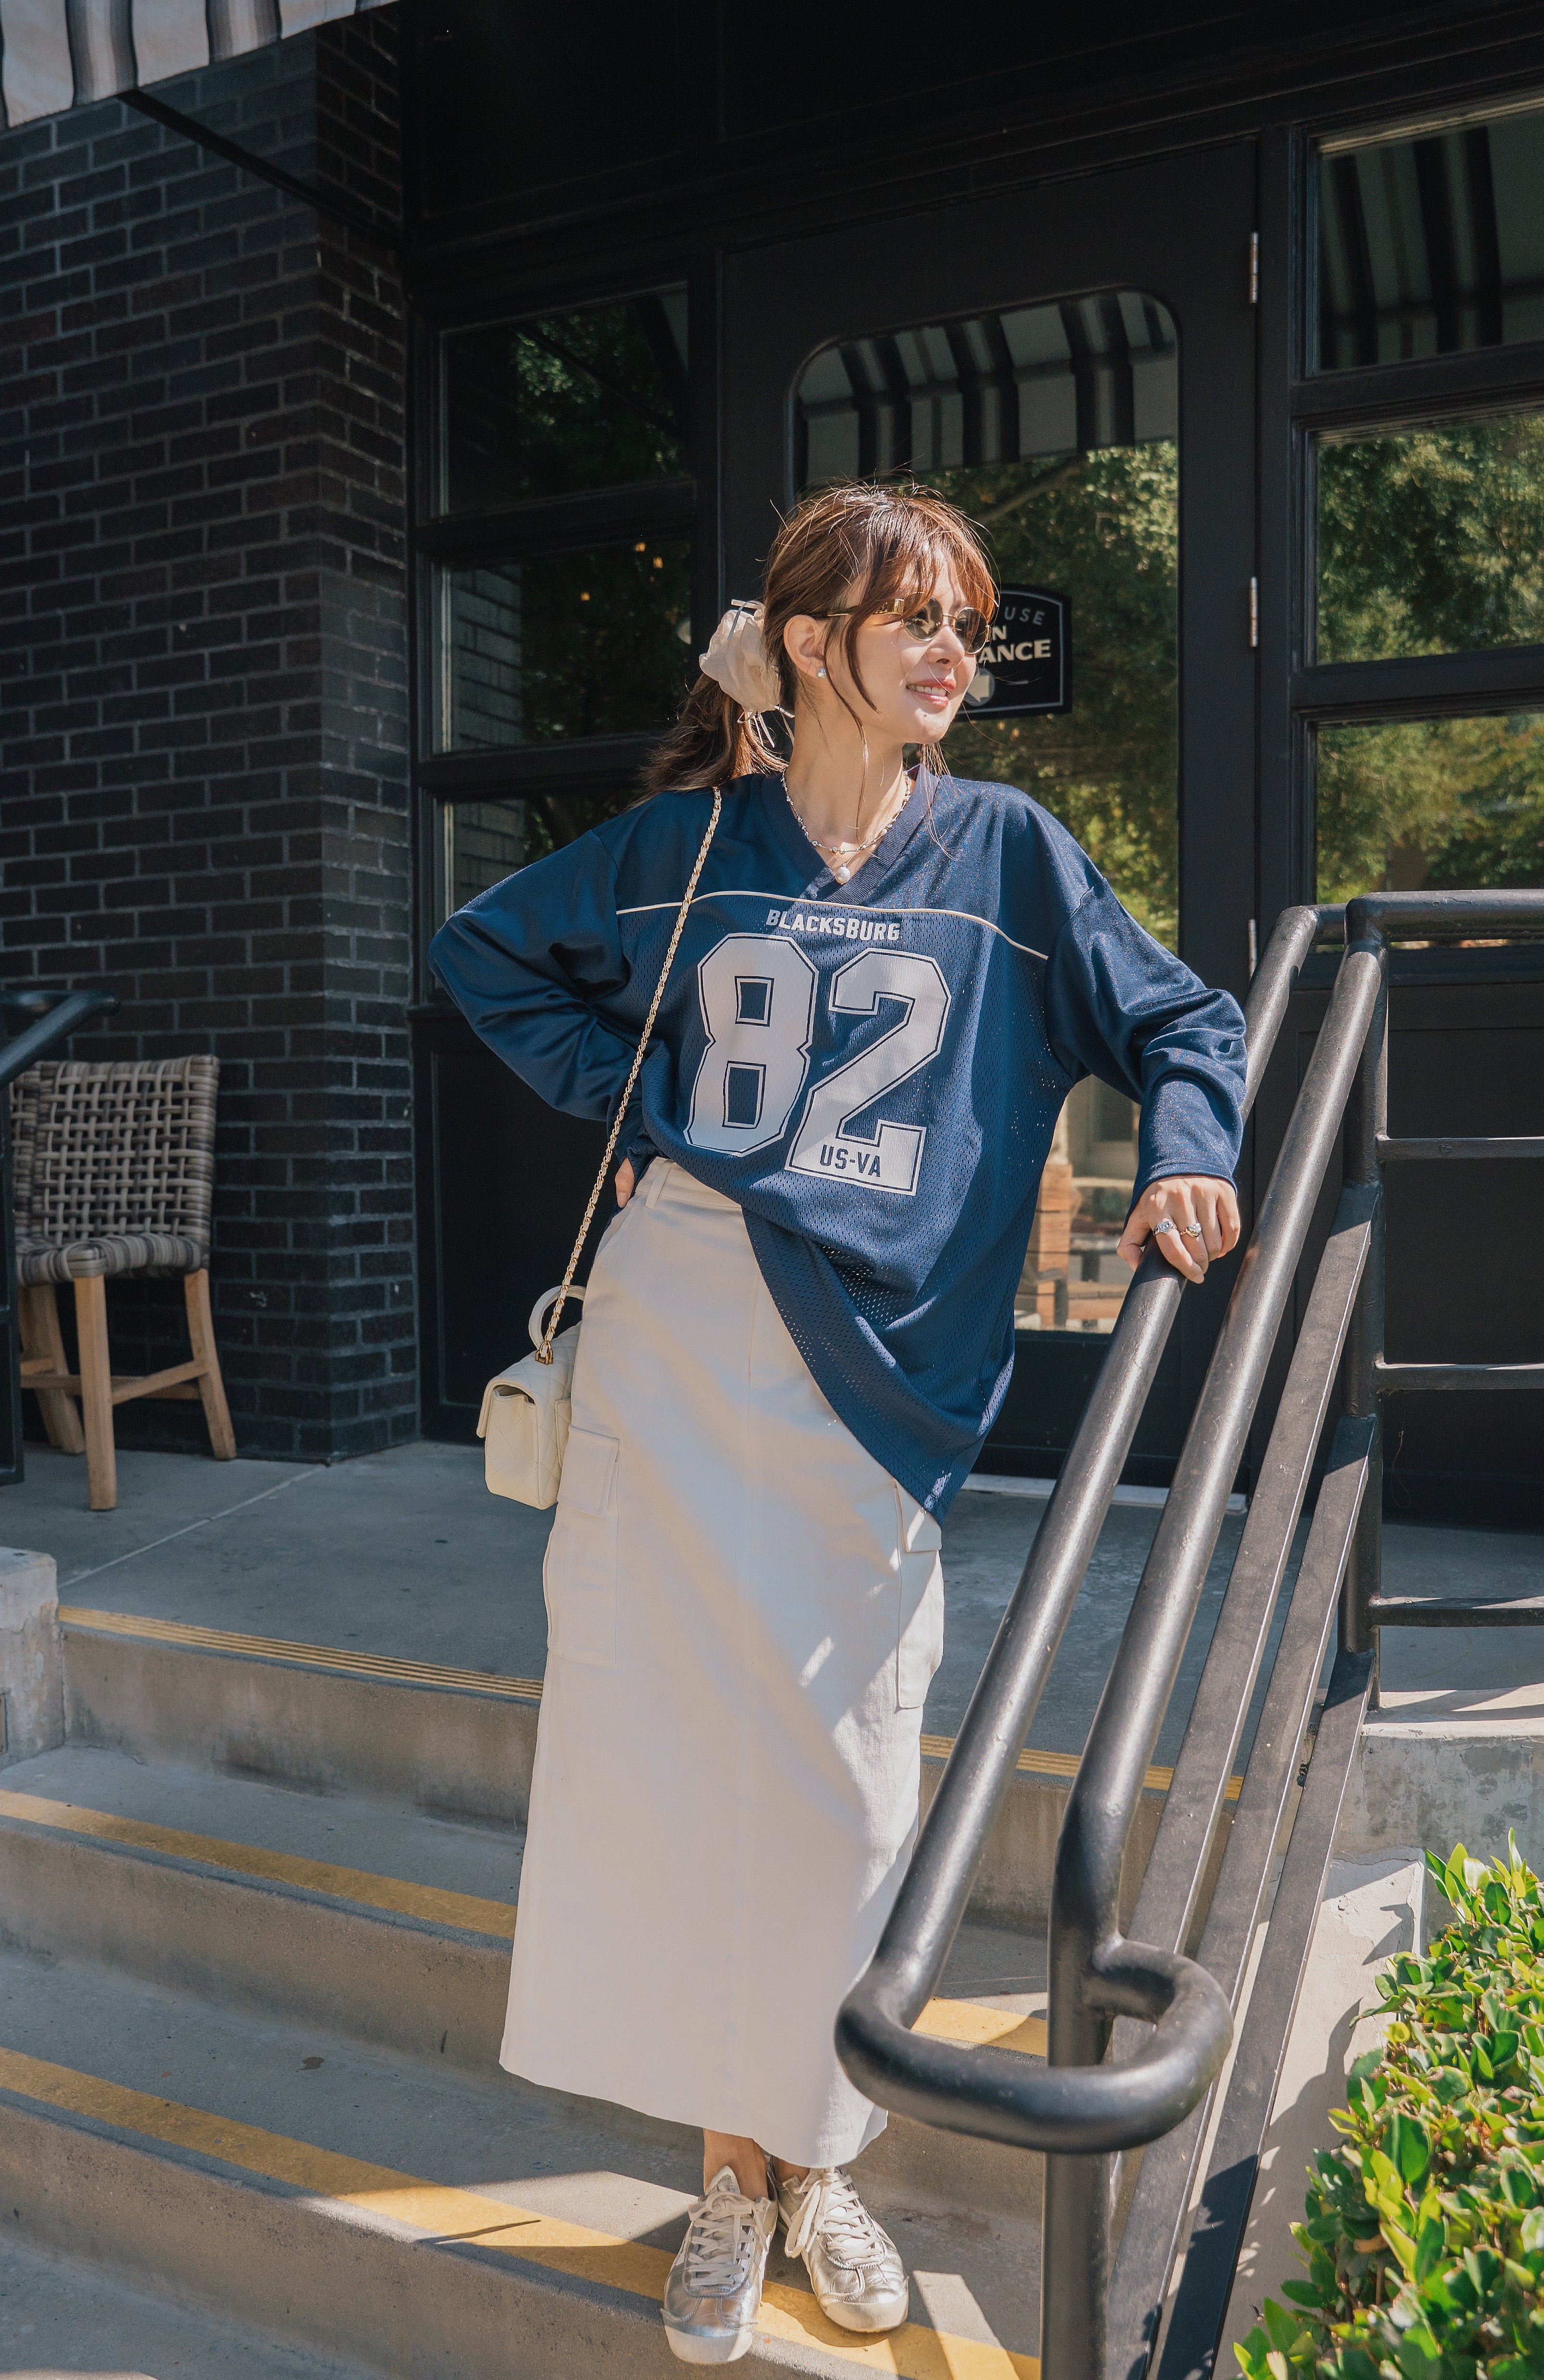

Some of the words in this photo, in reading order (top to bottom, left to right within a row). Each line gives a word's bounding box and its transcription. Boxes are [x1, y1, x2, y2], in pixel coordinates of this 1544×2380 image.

[766, 909, 901, 941] BLACKSBURG
[683, 932, 952, 1196] 82
[819, 1144, 882, 1178] US-VA
